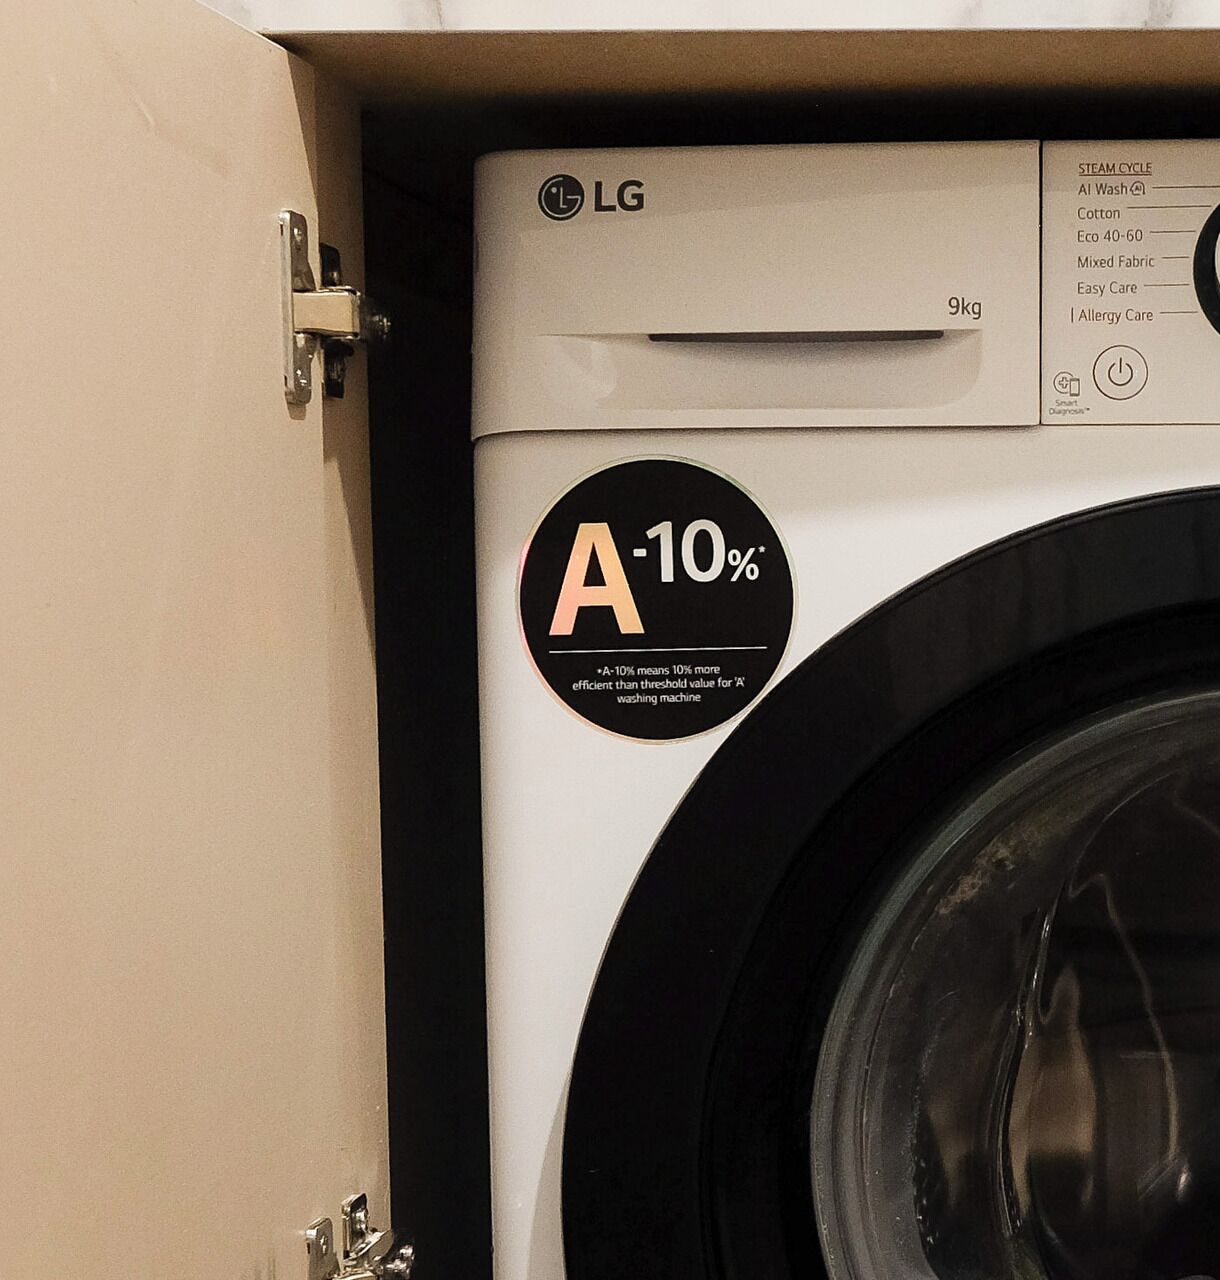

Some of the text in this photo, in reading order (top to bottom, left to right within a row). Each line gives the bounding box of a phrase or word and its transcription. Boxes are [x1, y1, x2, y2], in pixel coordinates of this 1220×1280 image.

[1078, 162, 1152, 174] STEAM CYCLE
[594, 180, 645, 212] LG
[1095, 182, 1129, 196] Wash
[1077, 207, 1121, 220] Cotton
[1077, 229, 1143, 243] Eco 40-60
[1077, 255, 1156, 269] Mixed Fabric
[1077, 281, 1138, 297] Easy Care
[948, 297, 983, 320] 9kg
[1078, 308, 1154, 324] Allergy Care
[549, 522, 645, 635] A
[637, 666, 670, 676] means
[672, 664, 693, 675] 10%
[694, 664, 721, 674] more
[572, 679, 614, 691] efficient
[615, 679, 639, 690] than
[640, 677, 687, 689] threshold
[689, 677, 716, 688] value
[717, 676, 733, 687] for
[616, 691, 702, 706] washing machine
